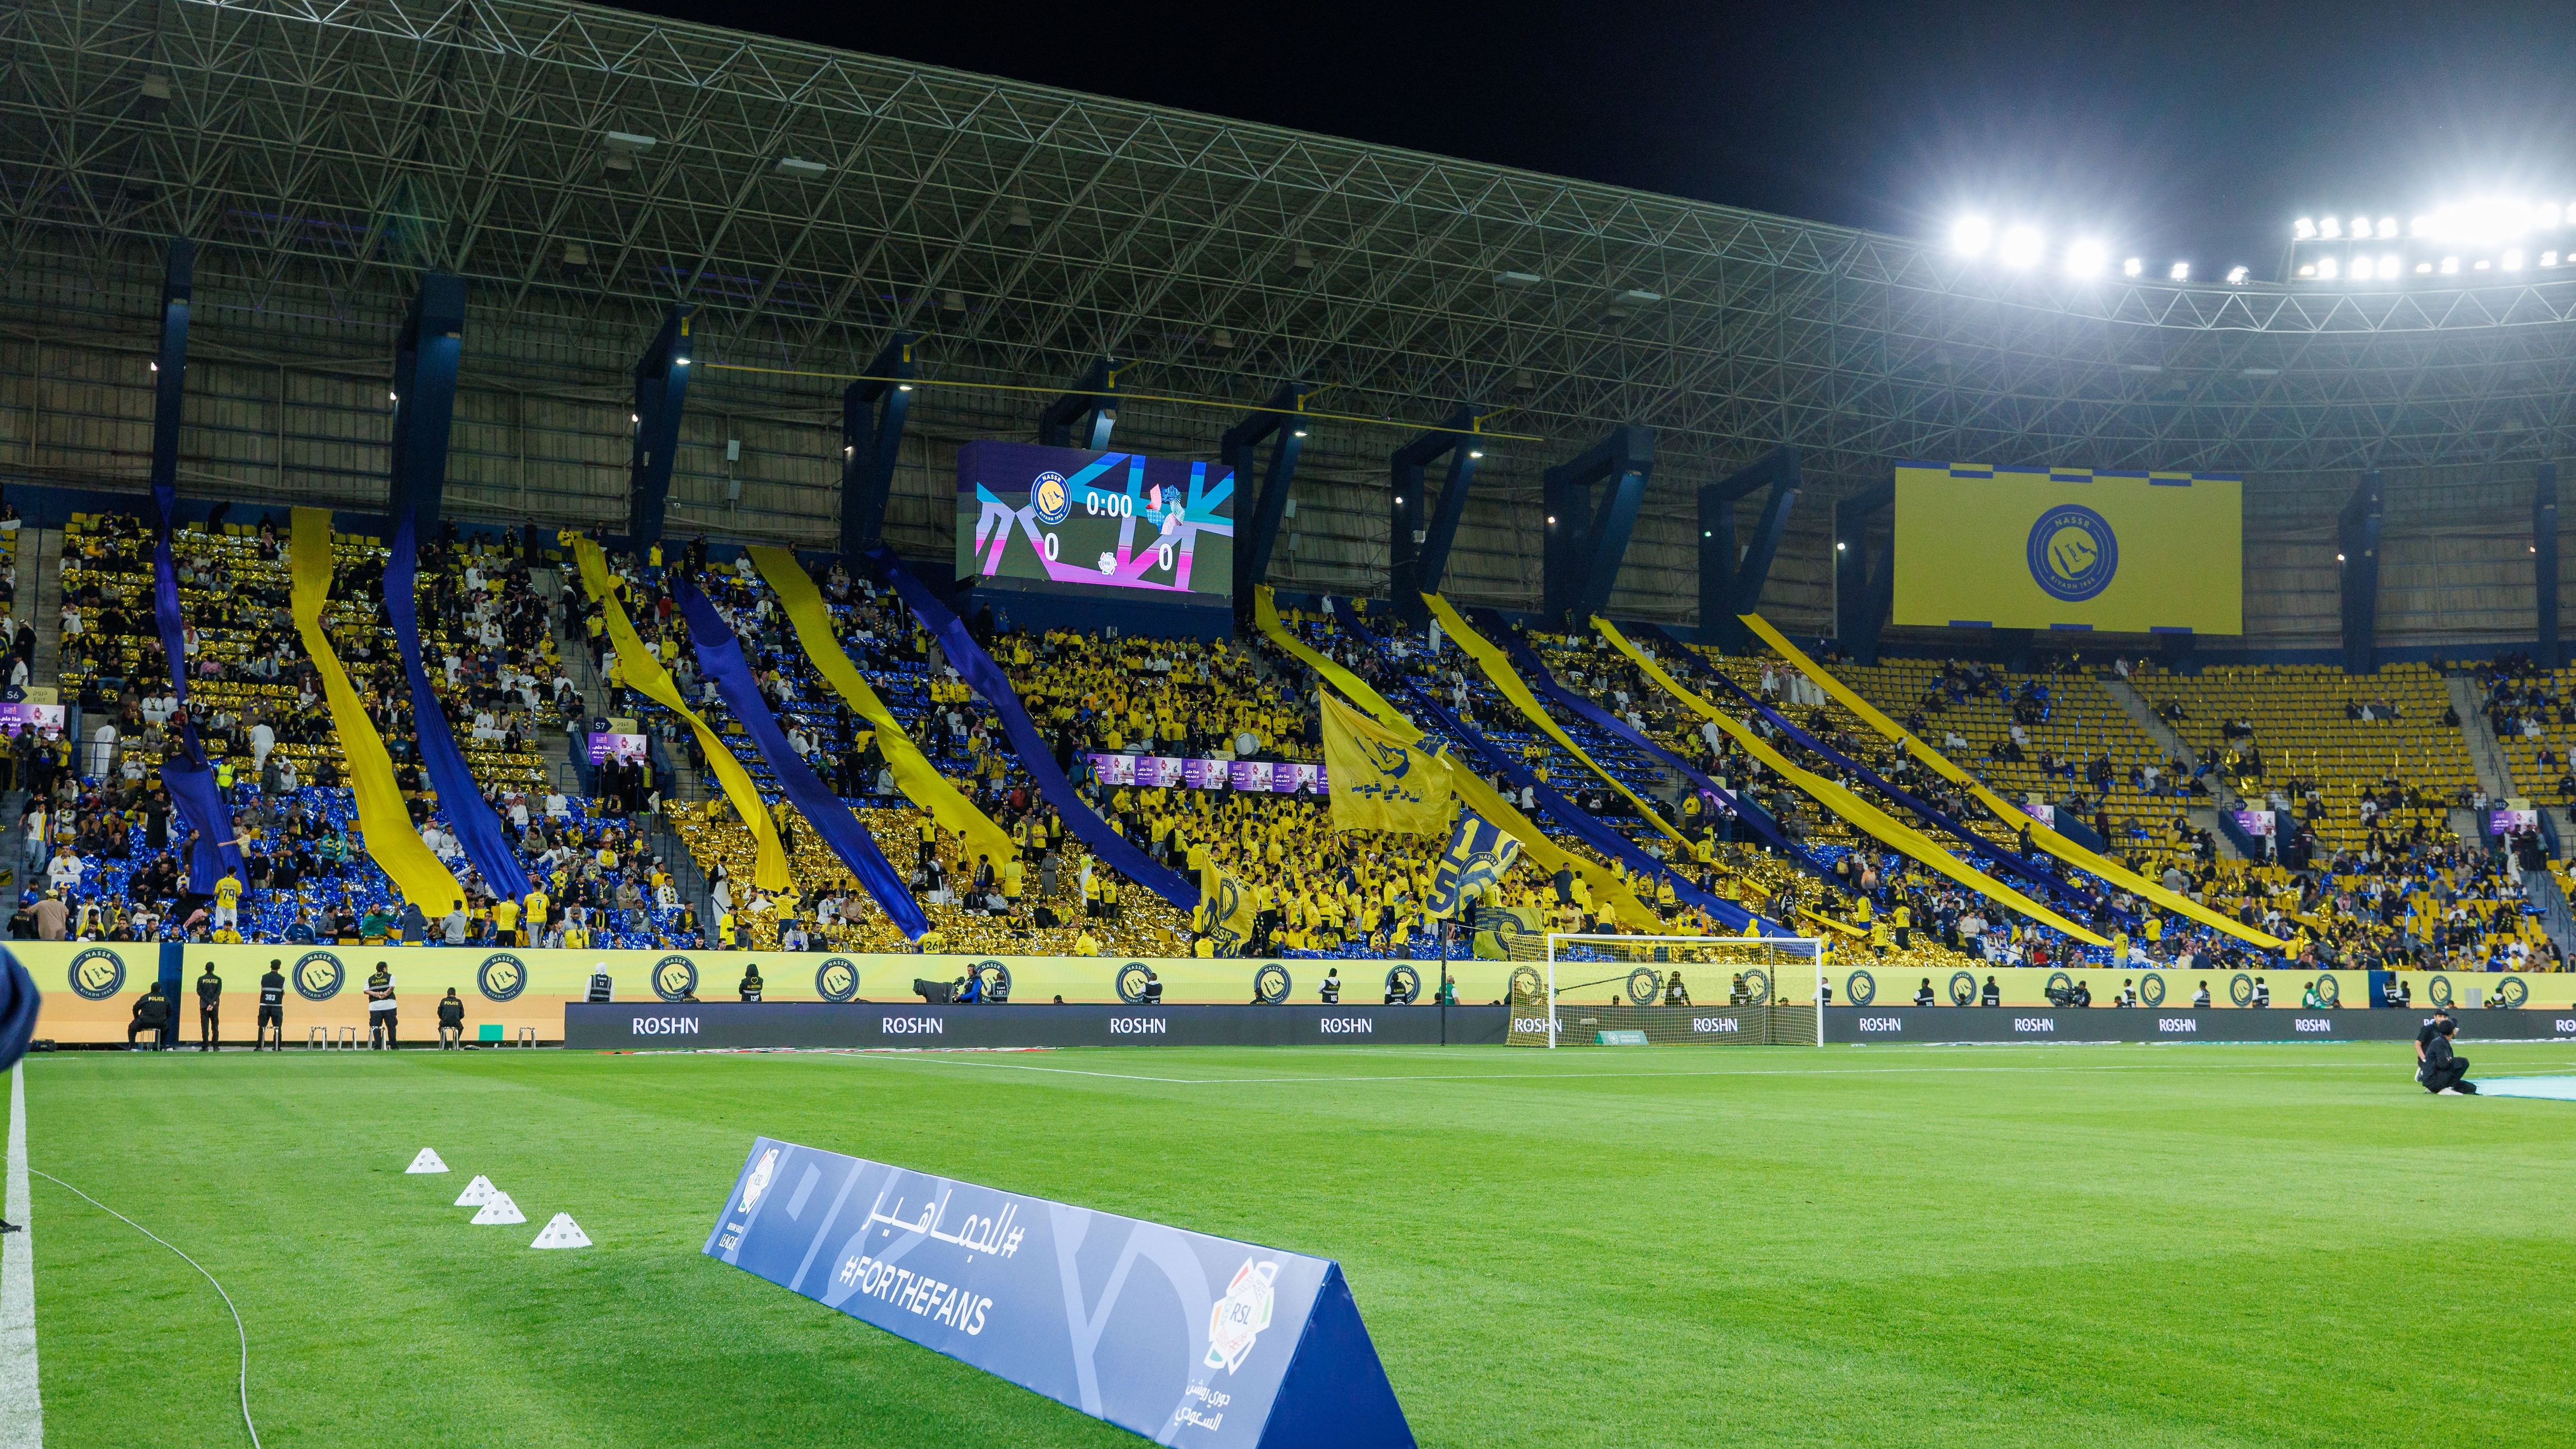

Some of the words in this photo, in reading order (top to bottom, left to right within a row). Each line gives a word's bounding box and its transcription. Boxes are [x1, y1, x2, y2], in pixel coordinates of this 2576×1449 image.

[1042, 474, 1061, 483] NASSR
[1086, 491, 1133, 519] 0:00
[1039, 511, 1054, 521] RIYADH
[2055, 516, 2090, 528] NASSR
[1044, 532, 1059, 562] 0
[1158, 544, 1173, 571] 0
[2049, 575, 2077, 589] RIYADH
[222, 888, 235, 900] 79
[536, 899, 542, 910] 7
[926, 940, 938, 951] 26
[80, 988, 99, 997] RIYADH
[302, 989, 321, 998] RIYADH
[487, 990, 504, 999] RIYADH
[633, 1017, 699, 1035] ROSHN
[882, 1017, 943, 1034] ROSHN
[1110, 1018, 1166, 1034] ROSHN
[1321, 1018, 1372, 1033] ROSHN
[1694, 1018, 1738, 1032] ROSHN
[1860, 1018, 1901, 1032] ROSHN
[2015, 1018, 2054, 1032] ROSHN
[2159, 1019, 2196, 1032] ROSHN
[2295, 1019, 2330, 1032] ROSHN
[862, 1189, 1025, 1263] #للجماهير
[719, 1233, 739, 1251] LEAGUE
[839, 1254, 994, 1336] #FORTHEFANS
[1230, 1302, 1251, 1325] RSL
[1185, 1379, 1208, 1402] روشن
[1206, 1392, 1231, 1409] دوري
[1174, 1406, 1224, 1431] السعودي
